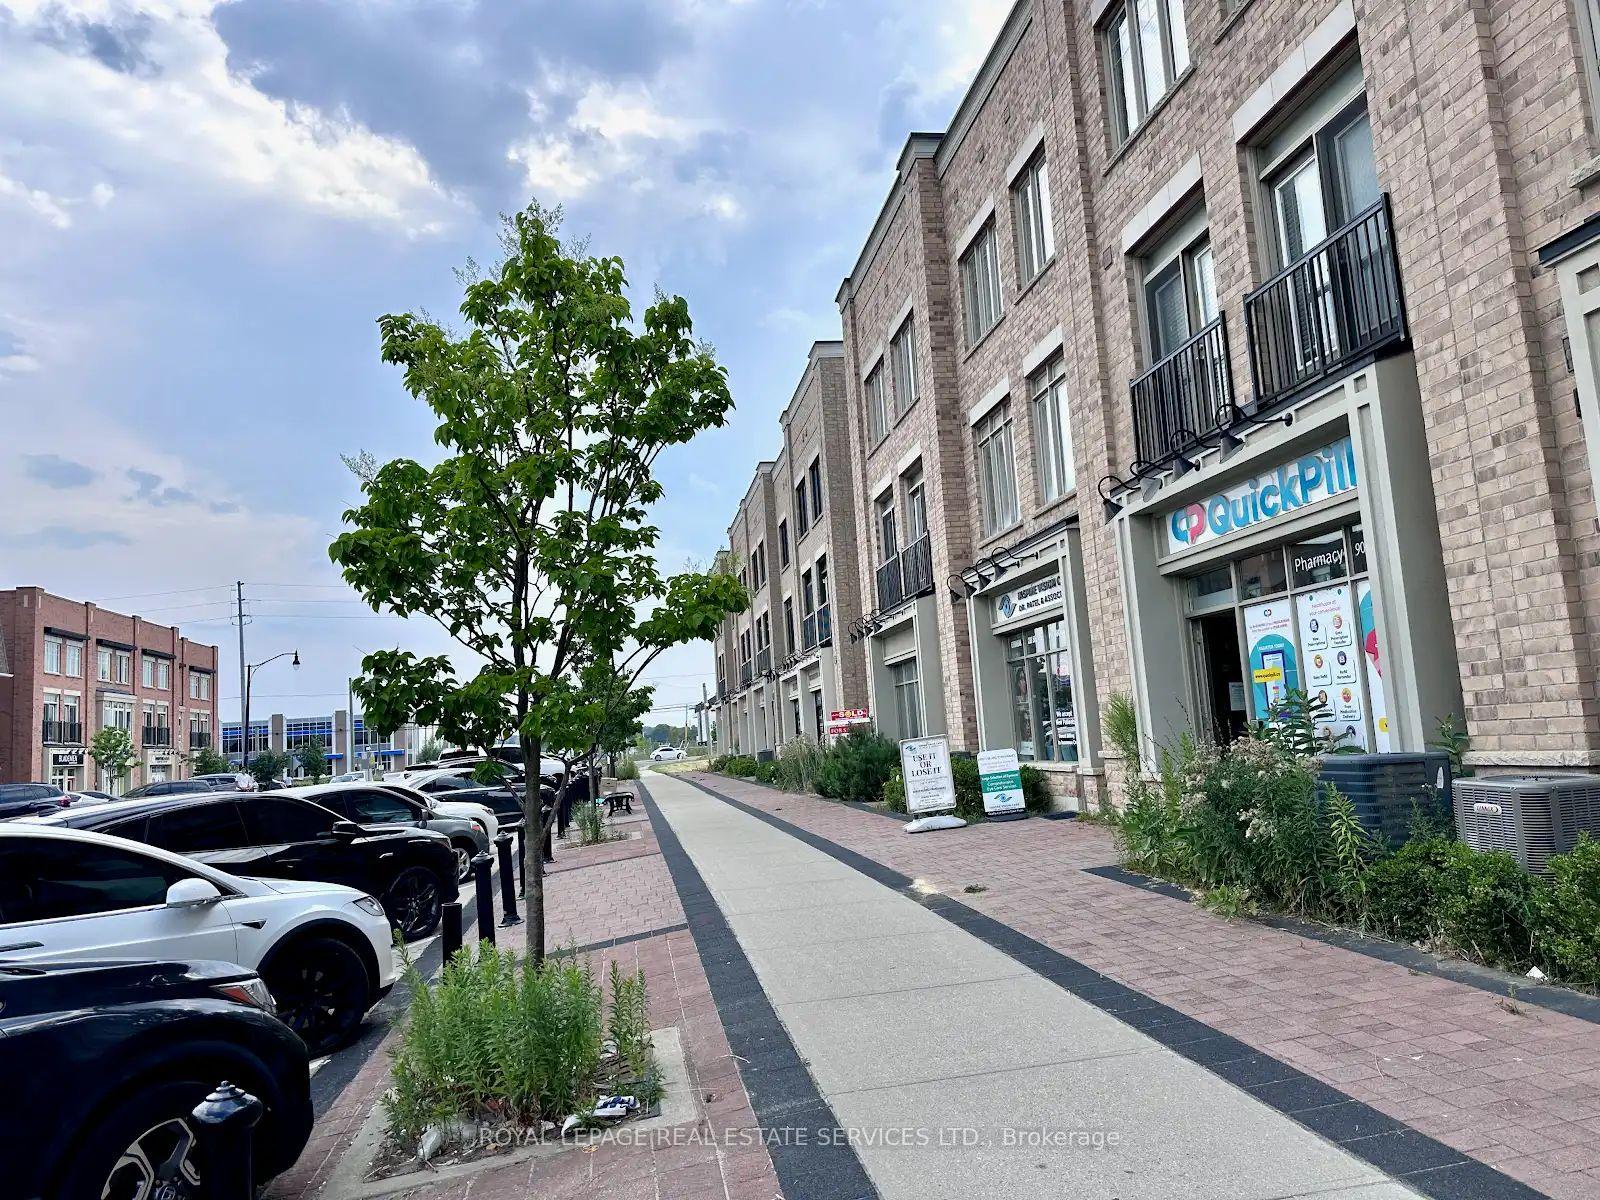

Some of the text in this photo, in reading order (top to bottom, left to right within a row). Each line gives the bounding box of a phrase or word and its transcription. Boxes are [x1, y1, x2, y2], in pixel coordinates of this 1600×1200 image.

[1207, 437, 1356, 536] QuickPill
[1294, 548, 1344, 572] Pharmacy
[839, 709, 864, 718] SOLD
[912, 752, 937, 762] USE IT
[919, 760, 932, 769] OR
[911, 766, 942, 777] LOSE IT
